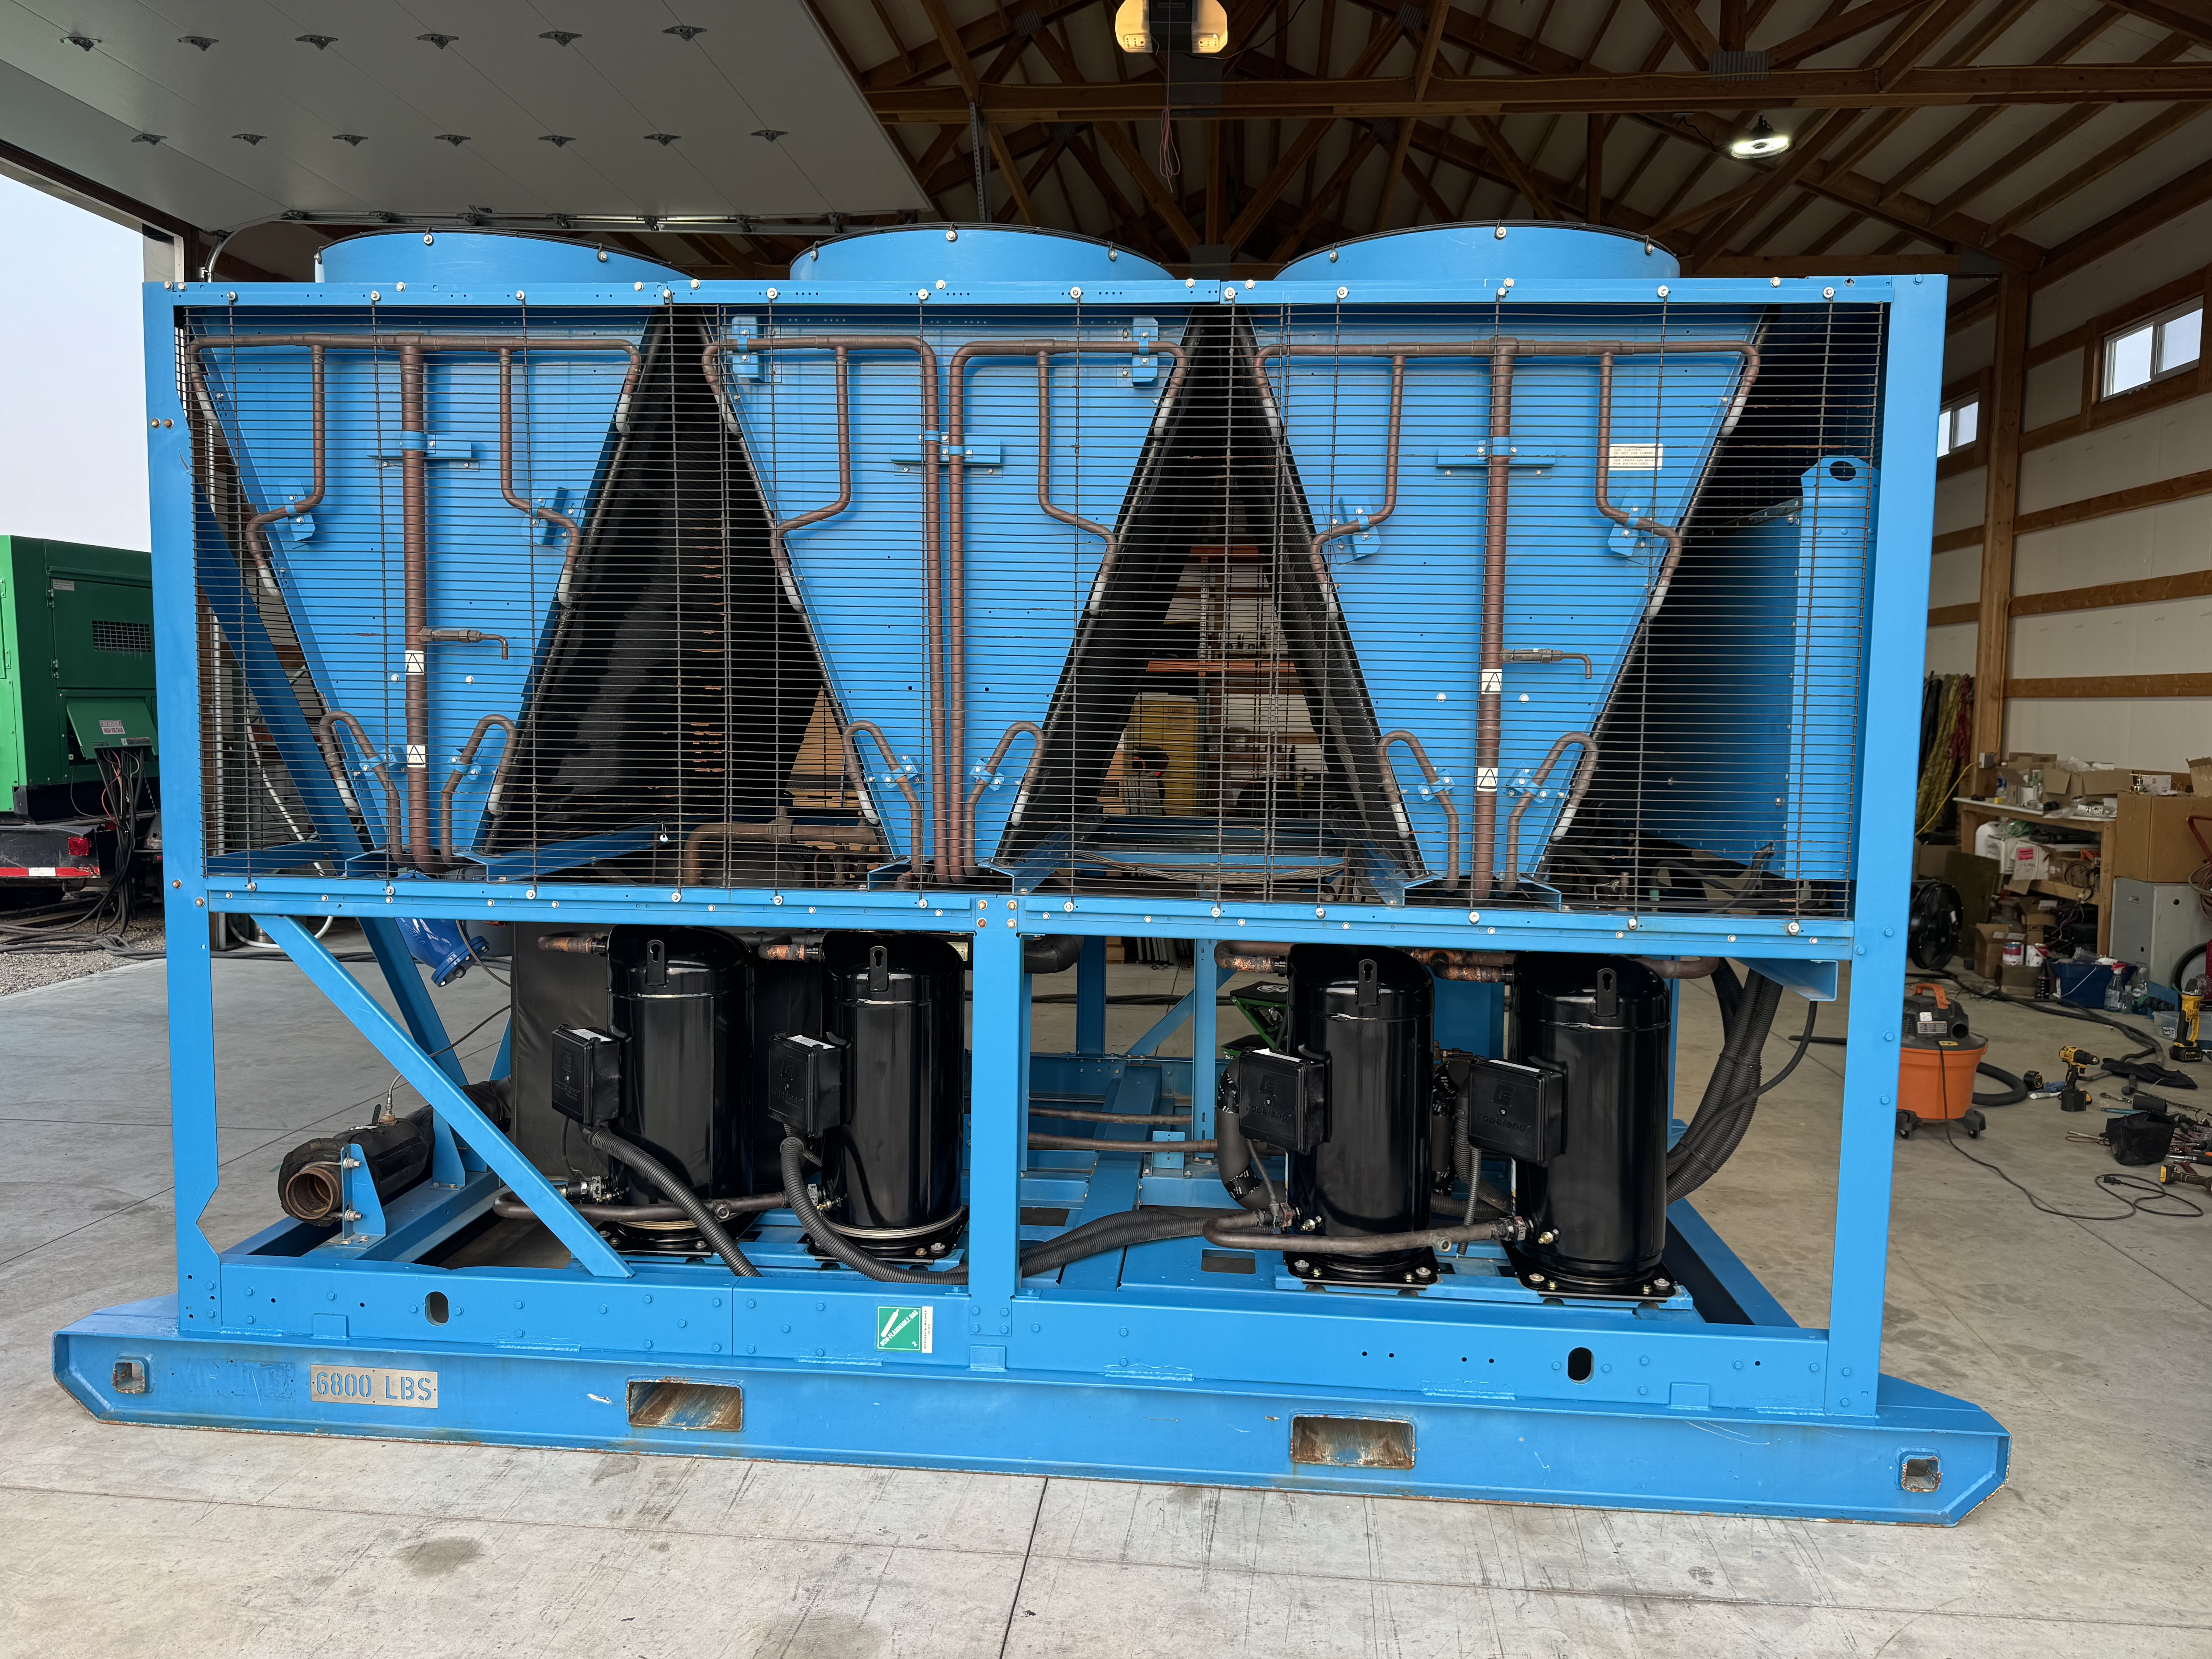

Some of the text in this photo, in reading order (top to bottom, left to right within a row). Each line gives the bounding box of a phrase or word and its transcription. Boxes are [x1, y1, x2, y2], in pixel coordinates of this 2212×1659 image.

[909, 1309, 919, 1319] GAS
[316, 1372, 431, 1401] 6800 LBS
